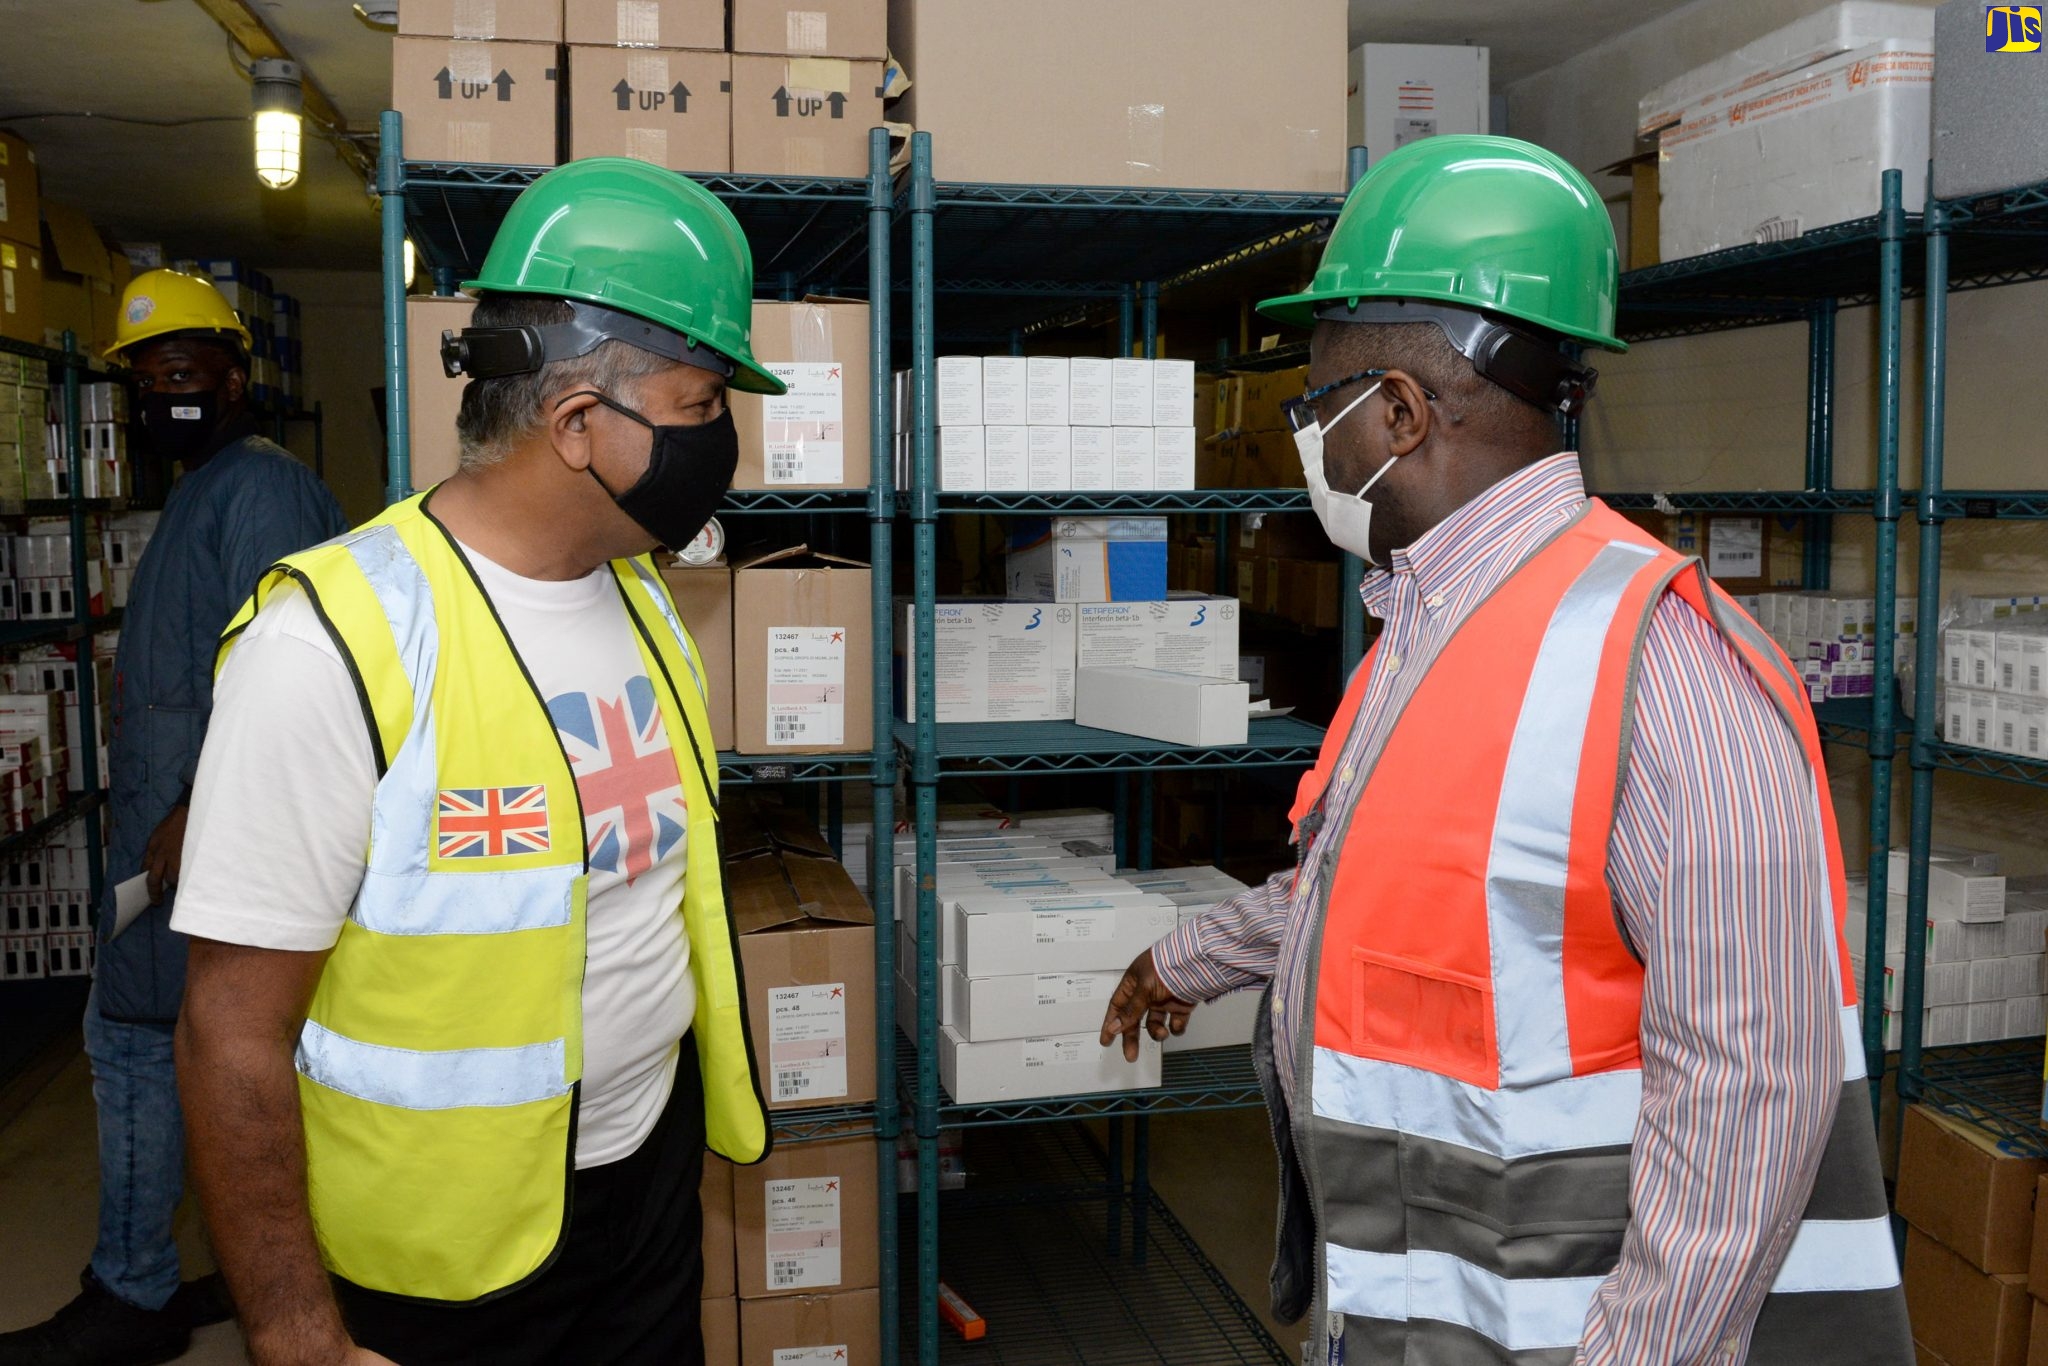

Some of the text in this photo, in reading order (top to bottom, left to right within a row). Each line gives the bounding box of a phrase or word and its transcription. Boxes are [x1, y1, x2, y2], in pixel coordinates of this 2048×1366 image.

[461, 82, 489, 99] UP
[639, 91, 666, 111] UP
[797, 98, 822, 117] UP
[775, 992, 799, 1000] 132467
